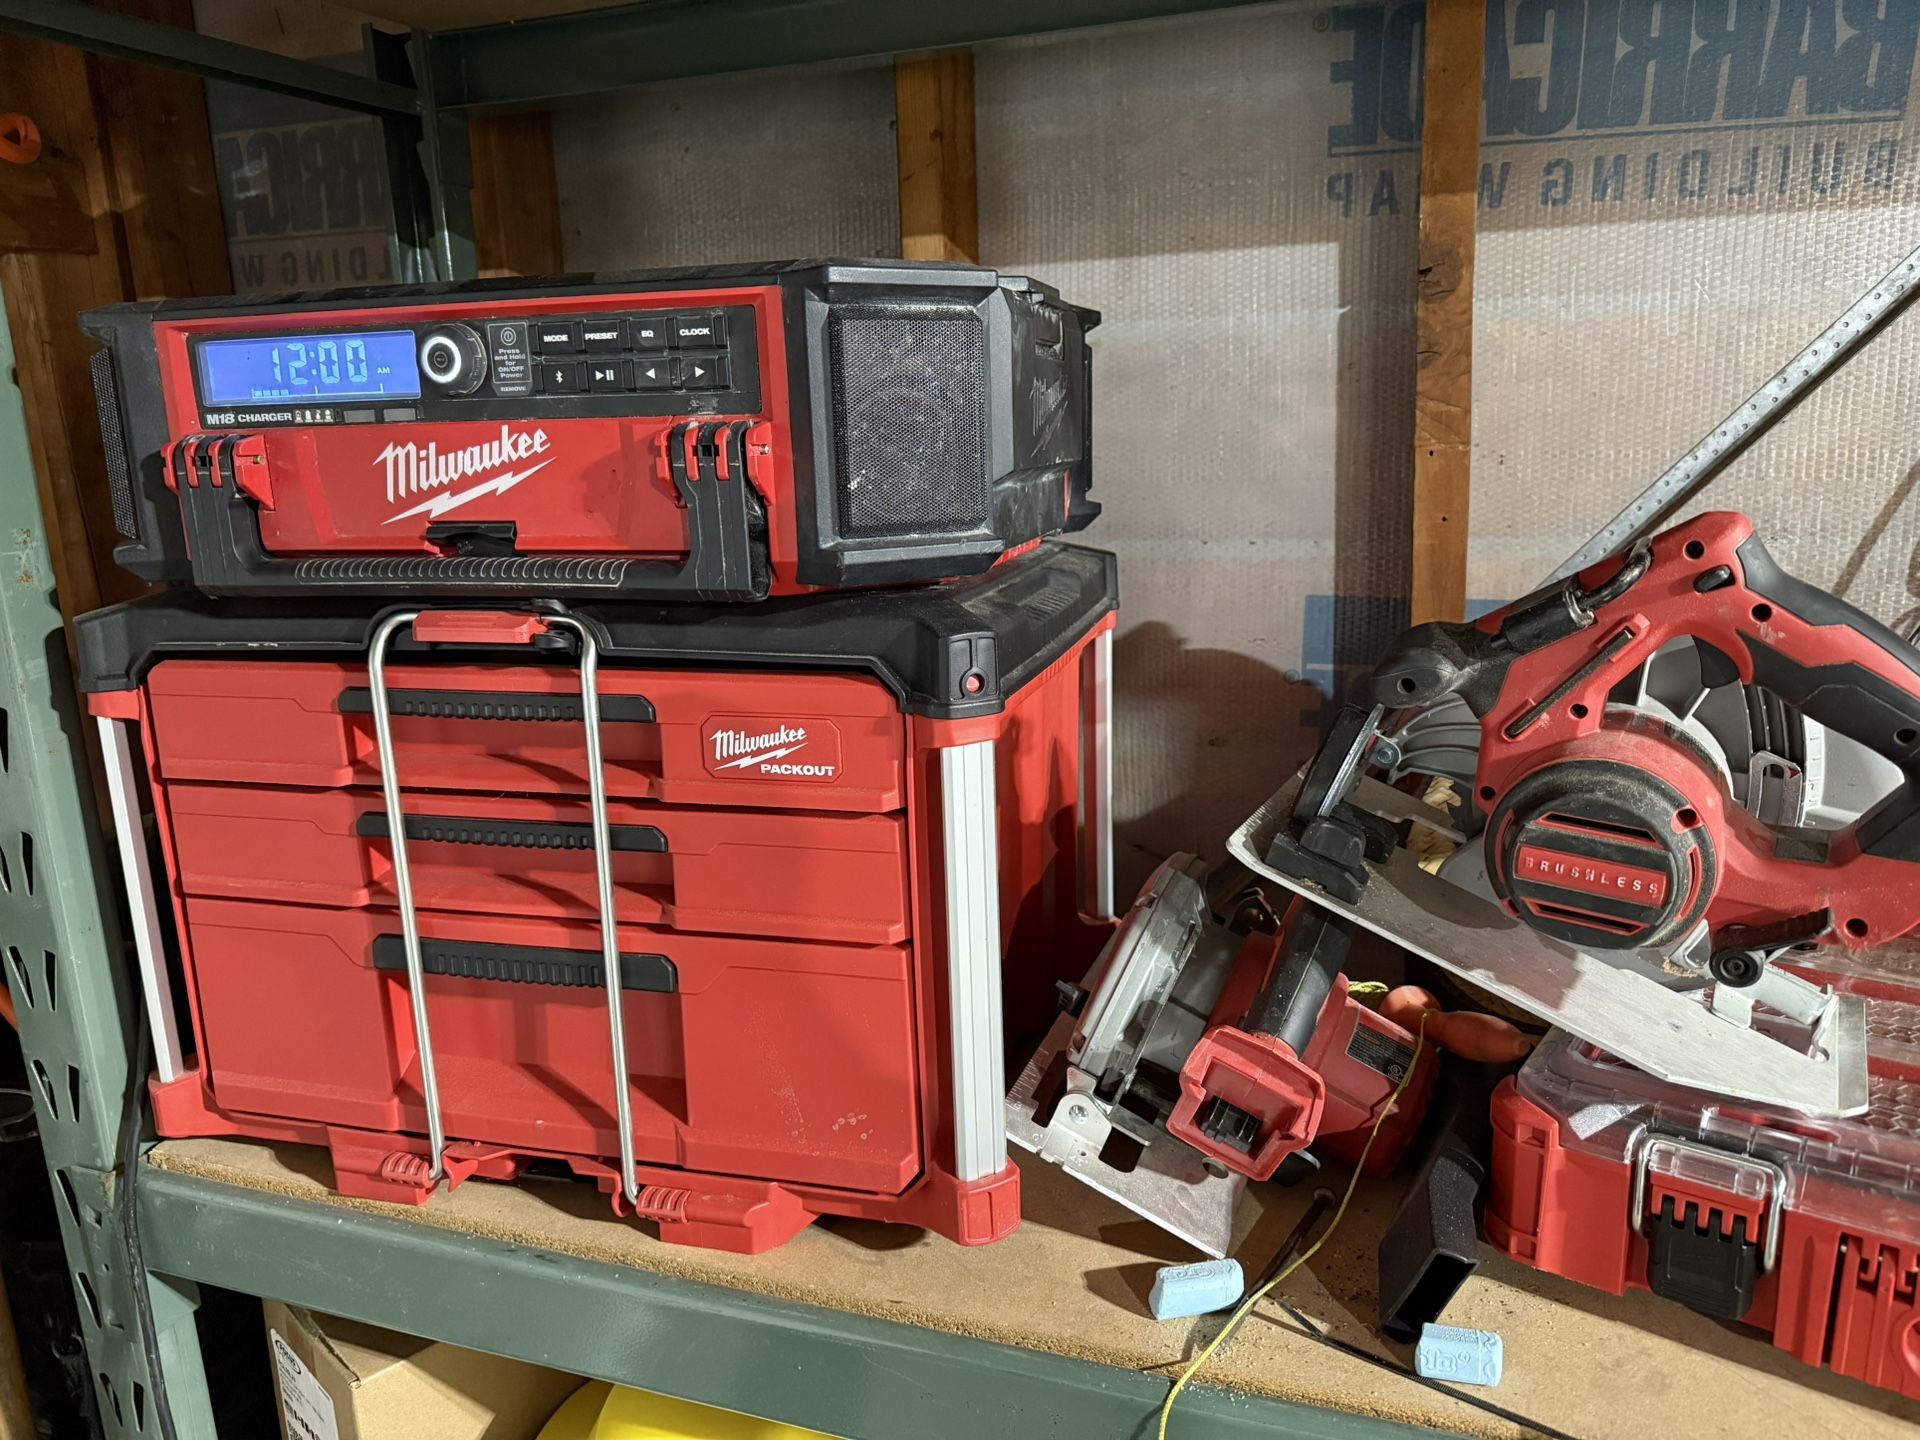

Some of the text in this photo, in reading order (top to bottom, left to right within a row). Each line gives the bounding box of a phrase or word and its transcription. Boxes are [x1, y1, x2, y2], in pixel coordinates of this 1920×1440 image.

[543, 334, 569, 342] MODE
[584, 331, 618, 341] PRESET
[641, 330, 654, 338] EQ
[679, 327, 711, 336] CLOCK
[271, 339, 368, 385] 12:00
[206, 412, 293, 425] M18 CHARGER
[372, 424, 552, 504] Milwaukee
[709, 724, 808, 761] Milwaukee
[760, 763, 836, 777] PACKOUT
[1524, 856, 1660, 896] BRUSHLESS
